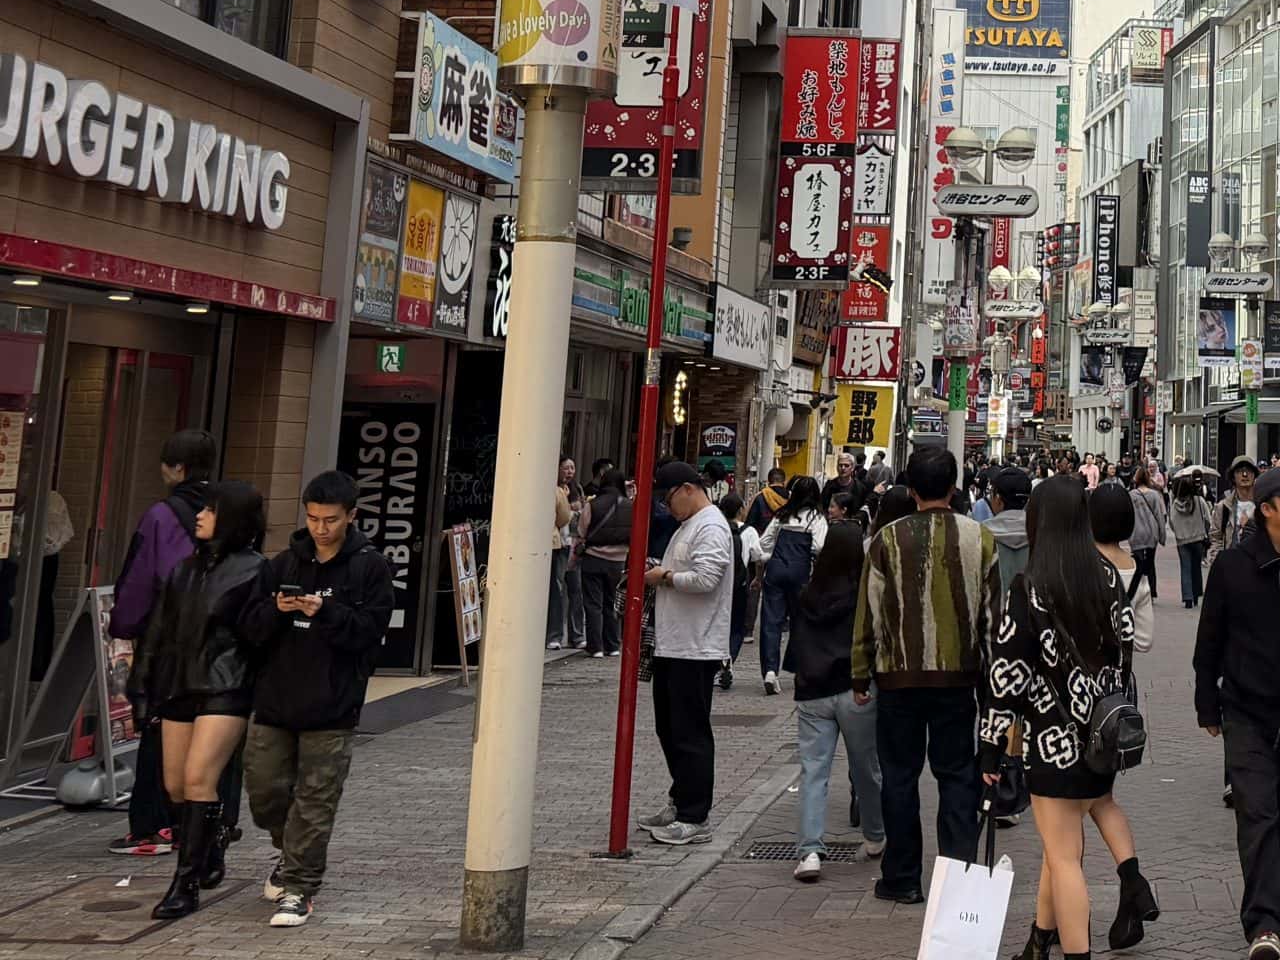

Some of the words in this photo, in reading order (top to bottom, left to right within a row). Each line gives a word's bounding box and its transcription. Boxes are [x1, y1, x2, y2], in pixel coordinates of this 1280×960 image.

[438, 55, 493, 148] 麻雀
[827, 39, 848, 140] 築地もんじゃ
[873, 43, 897, 128] 野郎ラーメン
[181, 121, 291, 231] KING
[842, 327, 893, 377] 豚
[846, 390, 878, 445] 野郎
